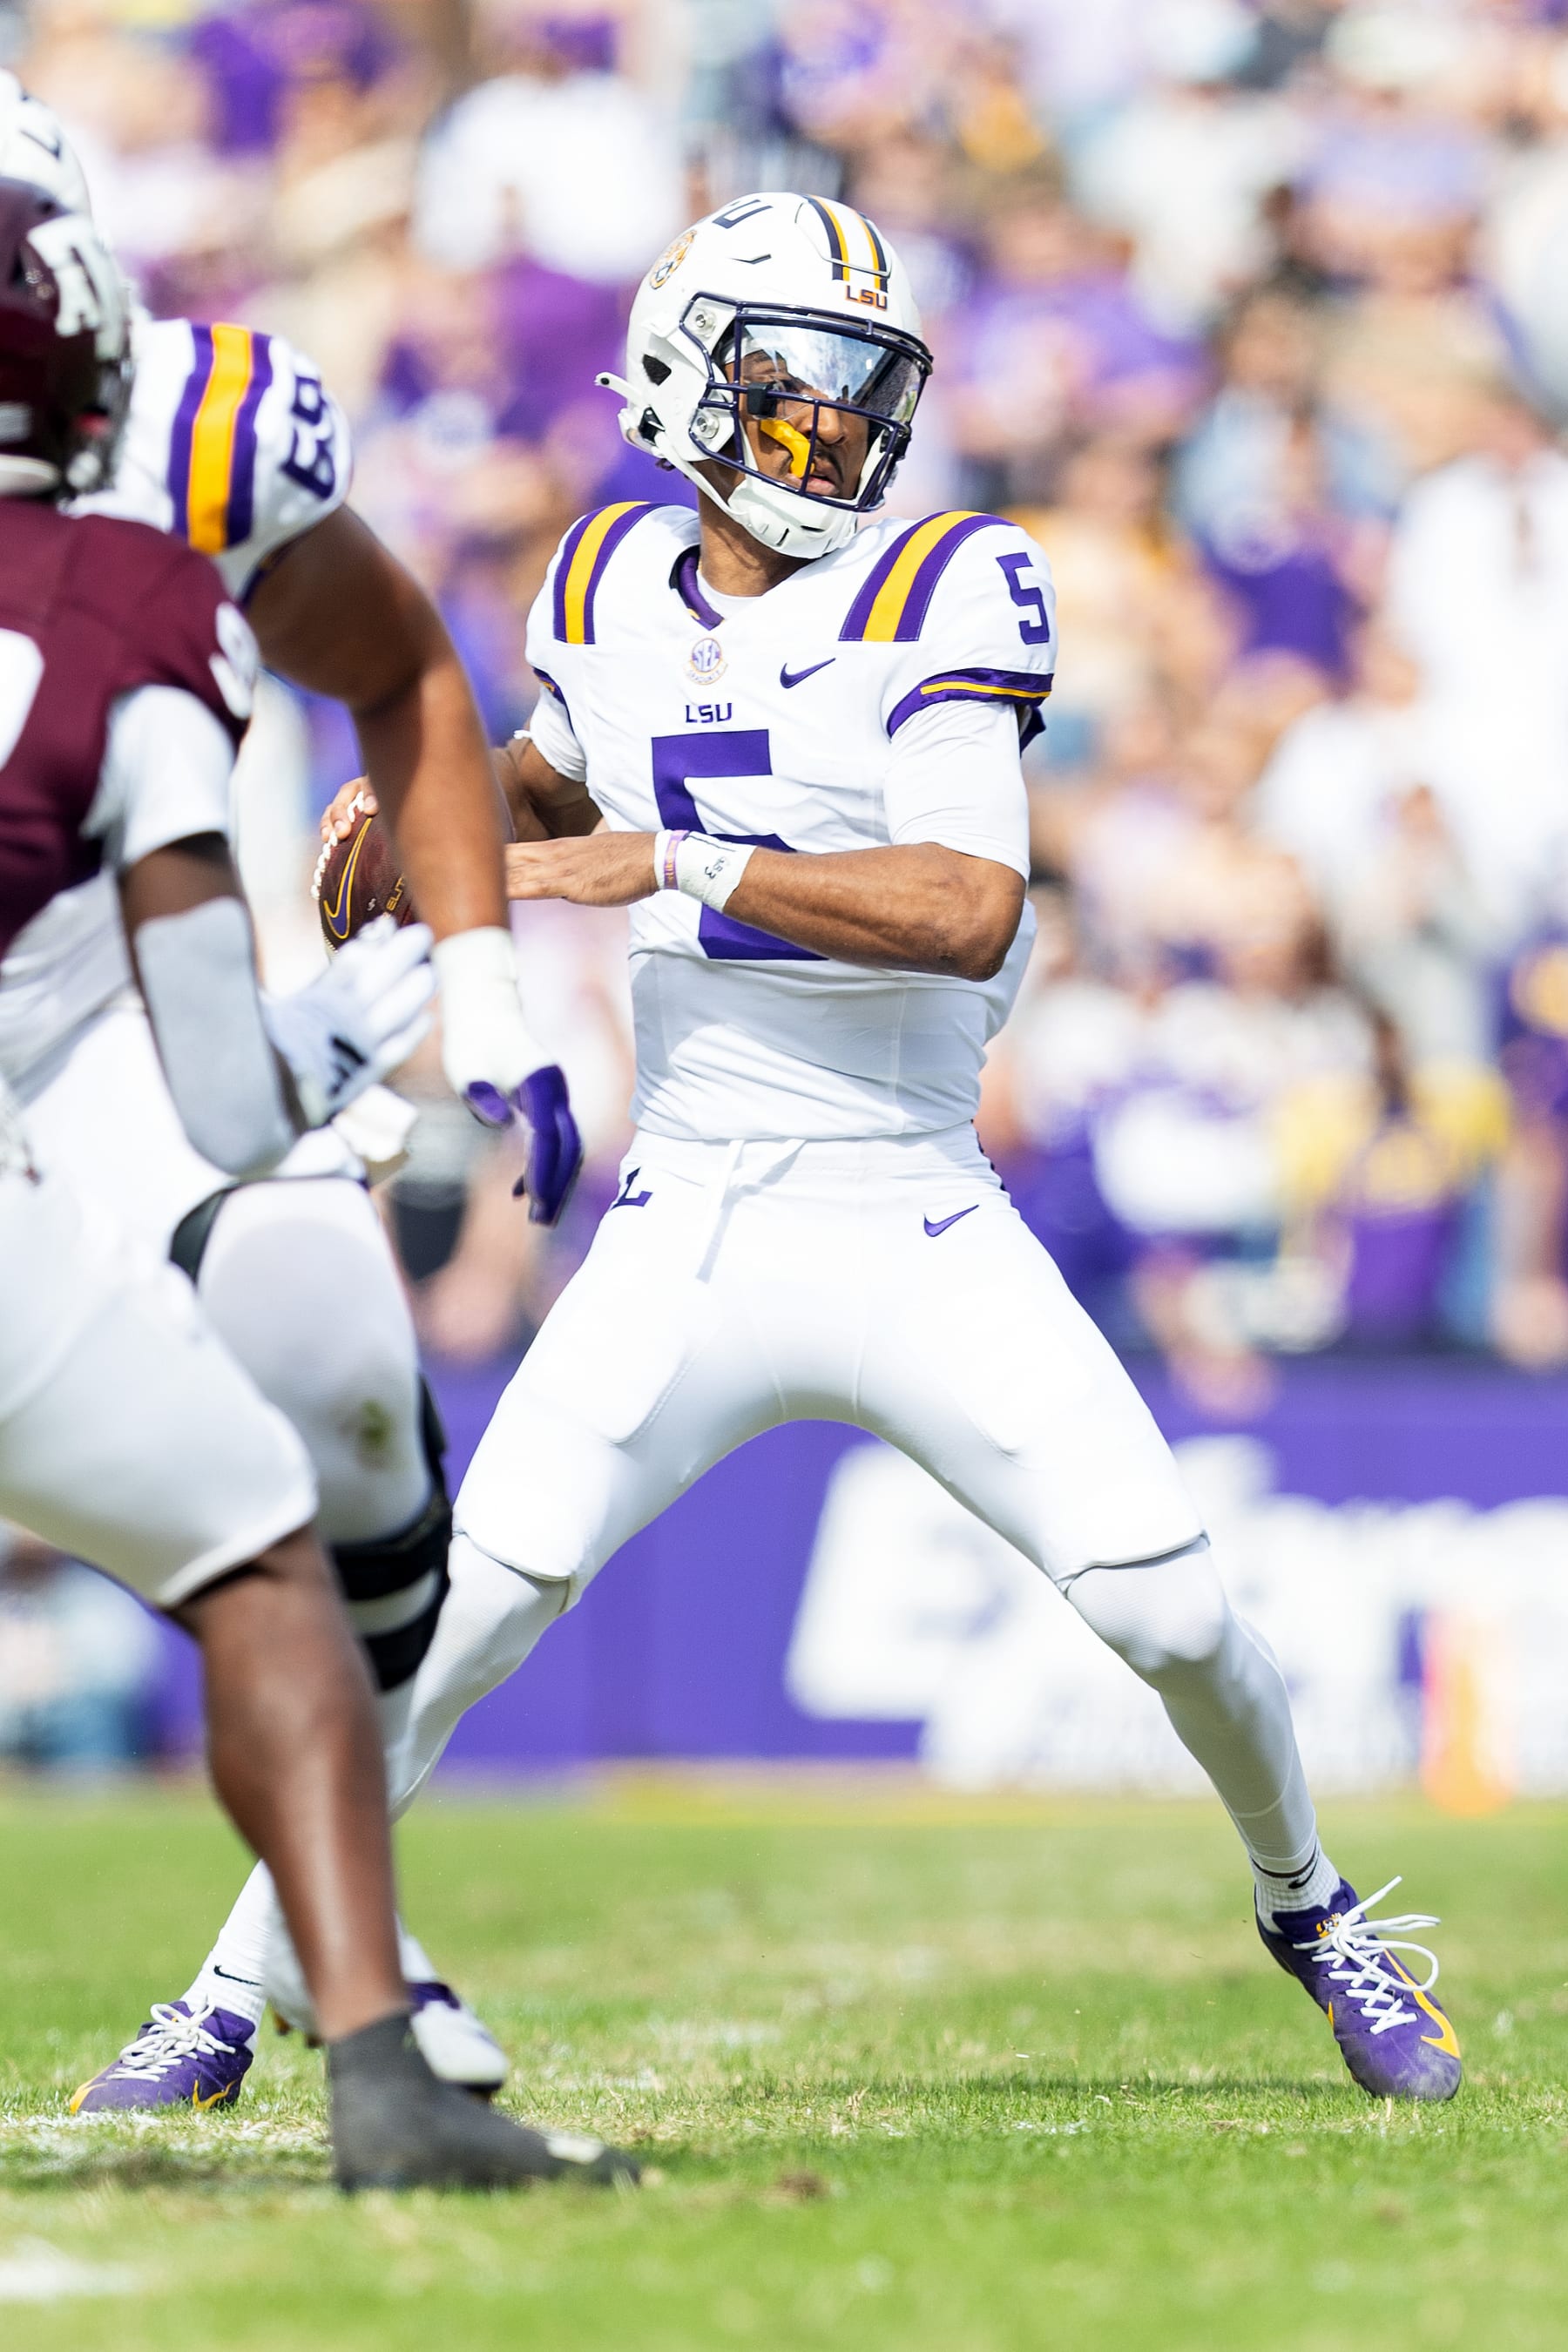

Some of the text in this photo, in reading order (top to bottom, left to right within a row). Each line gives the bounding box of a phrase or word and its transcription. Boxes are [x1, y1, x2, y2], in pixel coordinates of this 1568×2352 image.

[845, 285, 888, 311] LSU
[996, 552, 1051, 645] 5
[685, 702, 733, 723] LSU
[651, 728, 830, 960] 5
[386, 871, 406, 912] ELIT
